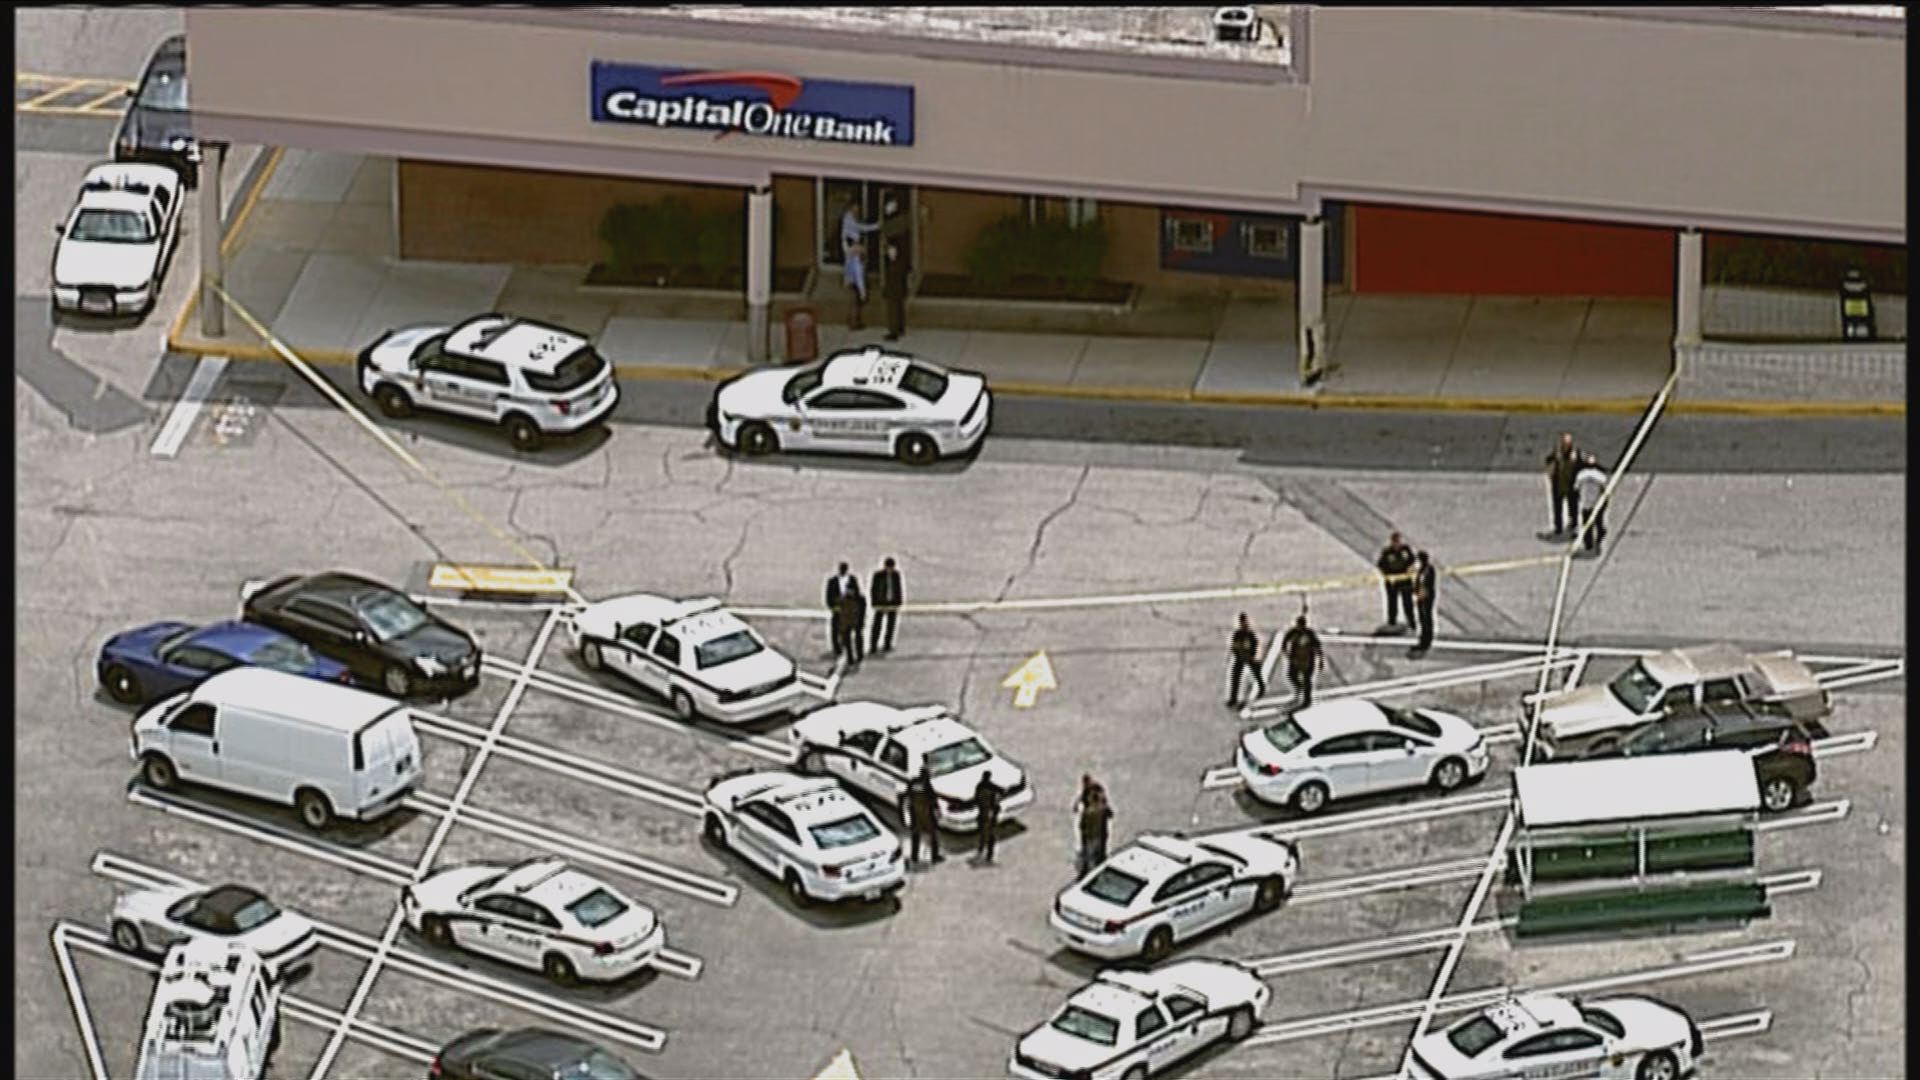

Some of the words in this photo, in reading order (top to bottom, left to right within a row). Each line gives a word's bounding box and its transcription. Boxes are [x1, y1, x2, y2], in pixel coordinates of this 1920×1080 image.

[606, 91, 741, 126] Capital
[744, 103, 811, 137] One
[814, 120, 895, 144] Bank
